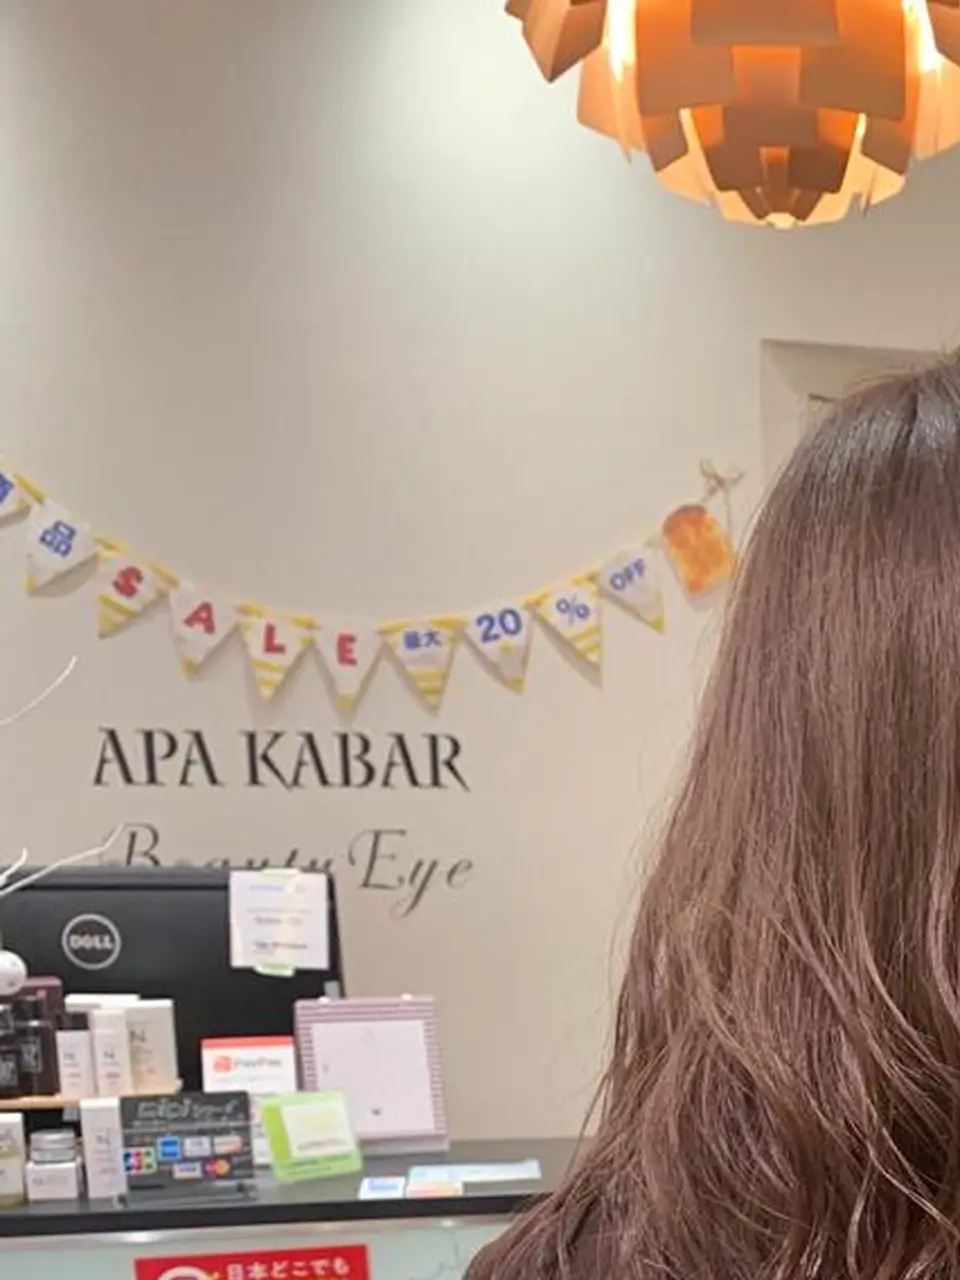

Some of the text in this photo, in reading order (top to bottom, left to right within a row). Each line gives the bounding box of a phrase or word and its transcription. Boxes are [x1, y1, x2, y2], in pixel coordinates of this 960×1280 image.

[609, 558, 647, 591] OFF
[93, 726, 471, 793] APA KABAR
[348, 829, 474, 919] Eye
